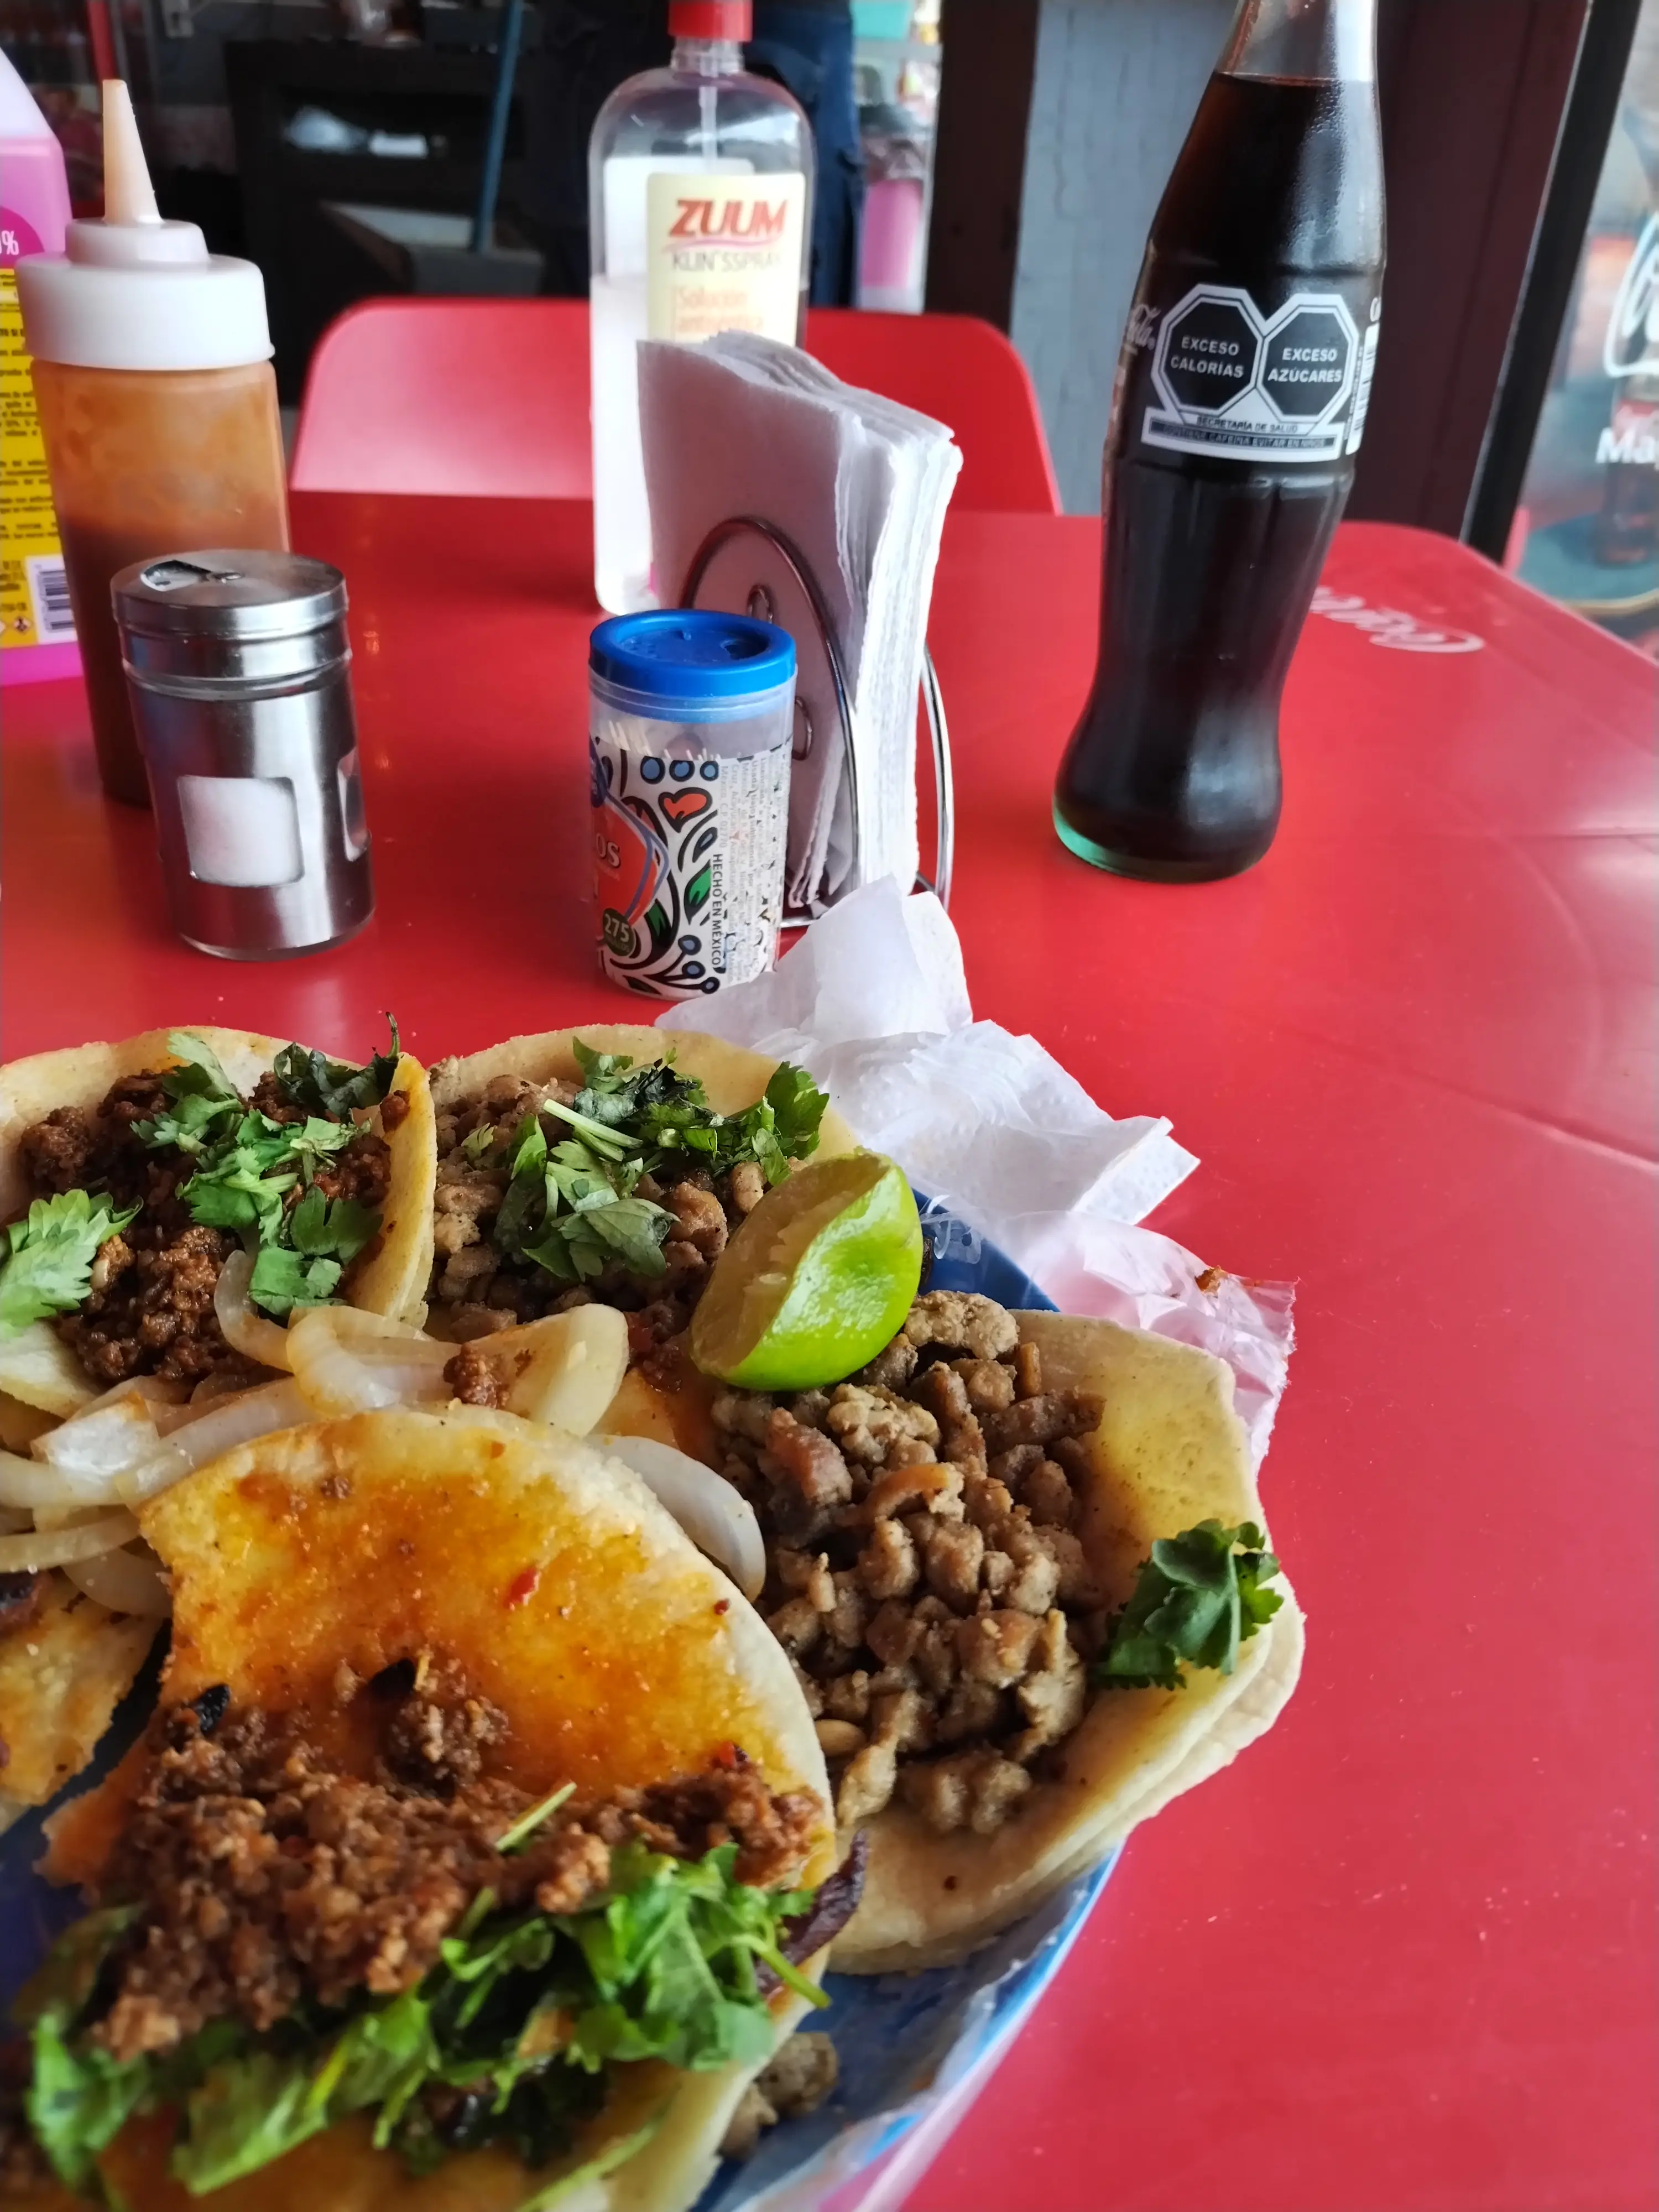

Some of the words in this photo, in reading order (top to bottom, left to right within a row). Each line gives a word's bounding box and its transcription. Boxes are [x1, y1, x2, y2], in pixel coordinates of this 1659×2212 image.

[669, 199, 788, 238] ZUUM
[1181, 336, 1239, 356] EXCESO
[1281, 347, 1338, 362] EXCESO
[1170, 356, 1244, 378] CALORÍAS
[1267, 367, 1342, 383] AZÚCARES
[1197, 416, 1253, 432] SECRETARÍA
[1255, 422, 1267, 432] DE
[1270, 423, 1298, 433] SALUD
[712, 854, 723, 898] HECHO
[712, 900, 722, 917] EN
[604, 913, 630, 943] 275
